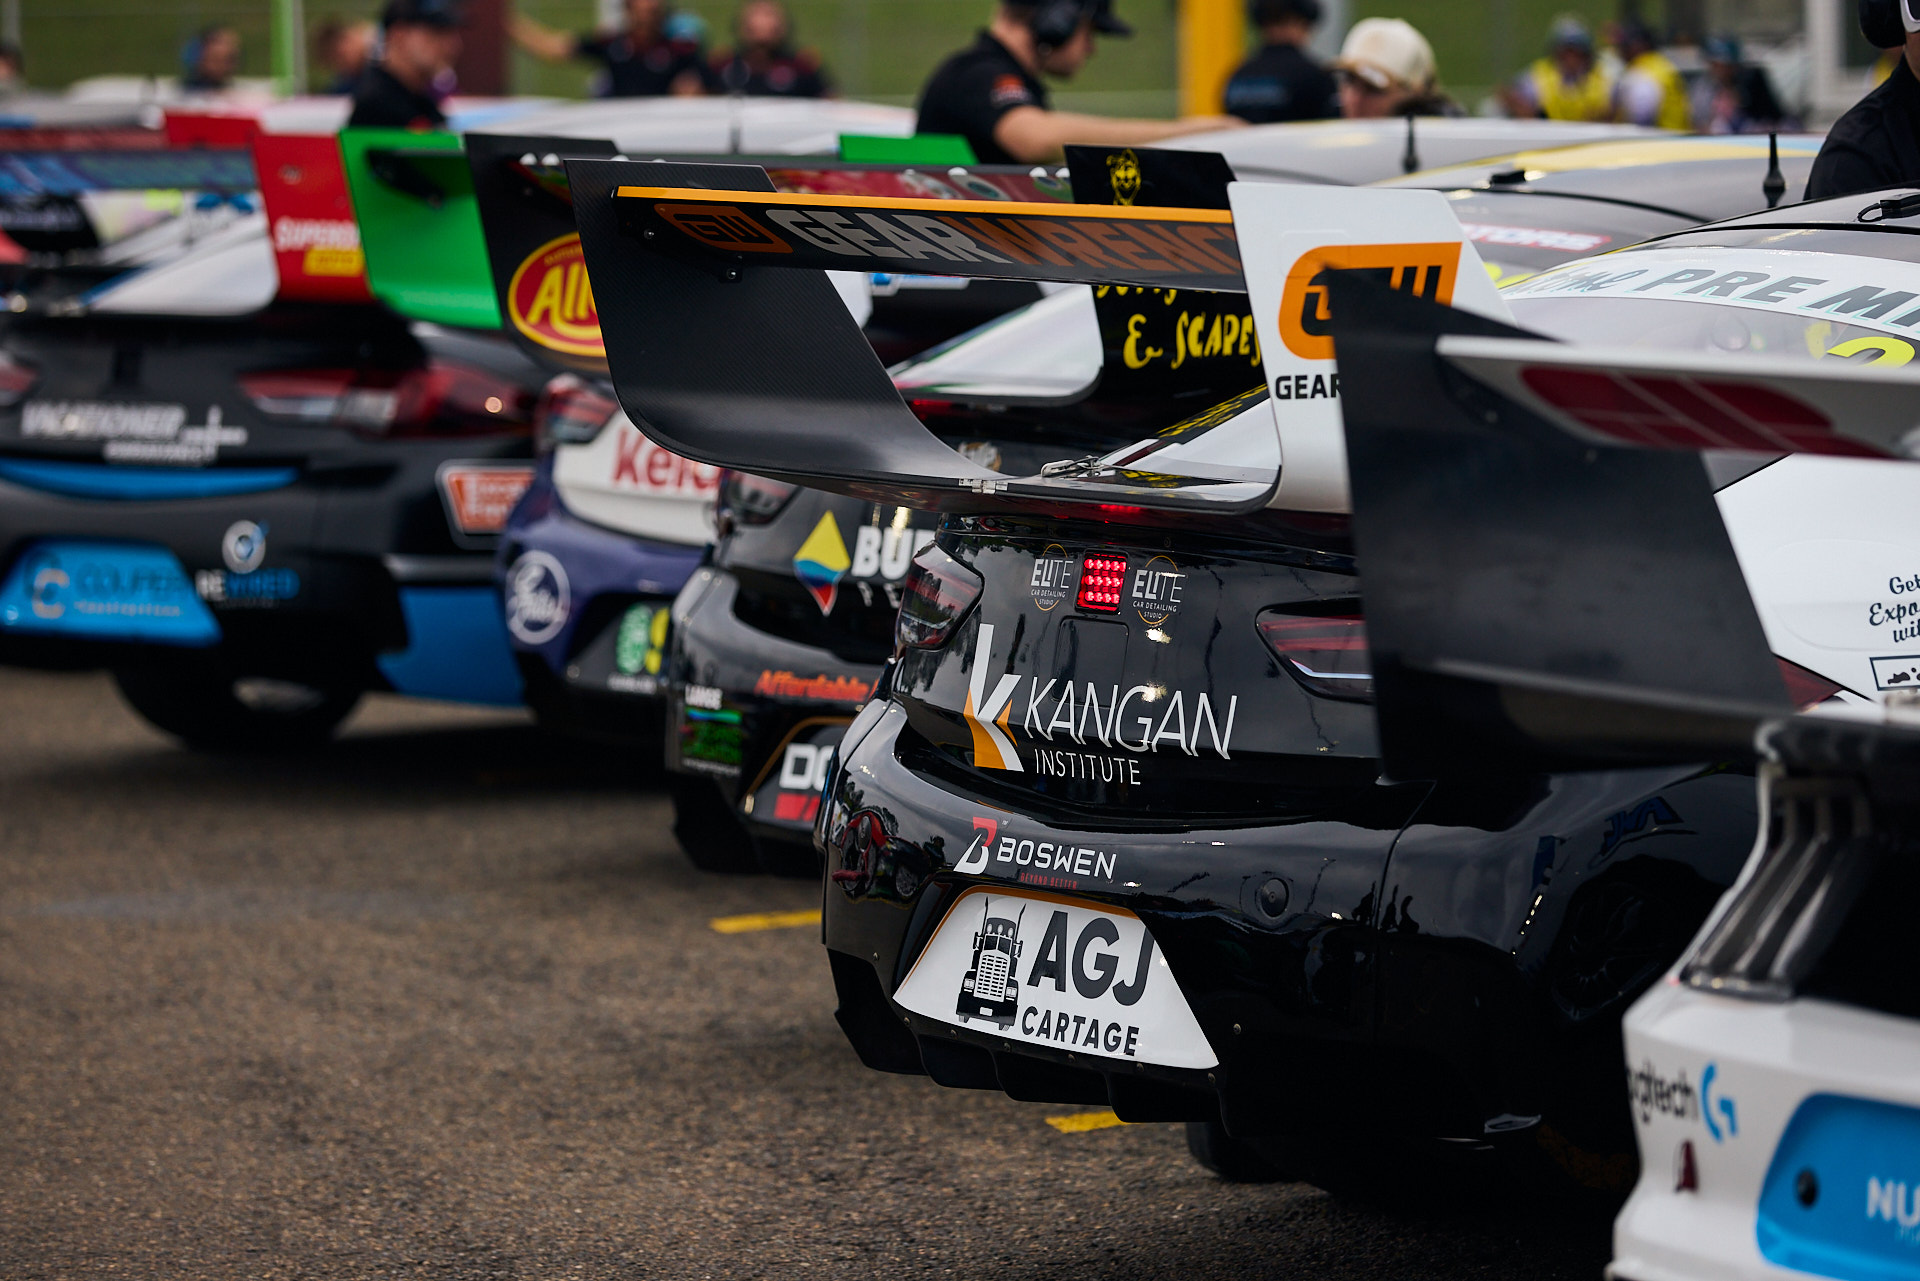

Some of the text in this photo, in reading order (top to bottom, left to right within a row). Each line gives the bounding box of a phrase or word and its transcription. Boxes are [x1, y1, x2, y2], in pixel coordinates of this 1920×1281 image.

[766, 209, 1242, 275] GEARWRENC
[851, 525, 937, 580] BU
[1030, 558, 1074, 589] ELITE
[1131, 569, 1187, 603] ELITE
[1041, 590, 1066, 598] DETAILING
[1132, 600, 1177, 613] CAR DETAILING
[1143, 611, 1162, 619] STUDIO
[1869, 602, 1920, 627] Expo
[1024, 676, 1238, 760] KANGAN
[1034, 748, 1142, 785] INSTITUTE
[996, 836, 1118, 880] BOSWEN
[1027, 910, 1156, 1007] AGJ
[1021, 1005, 1140, 1056] CARTAGE
